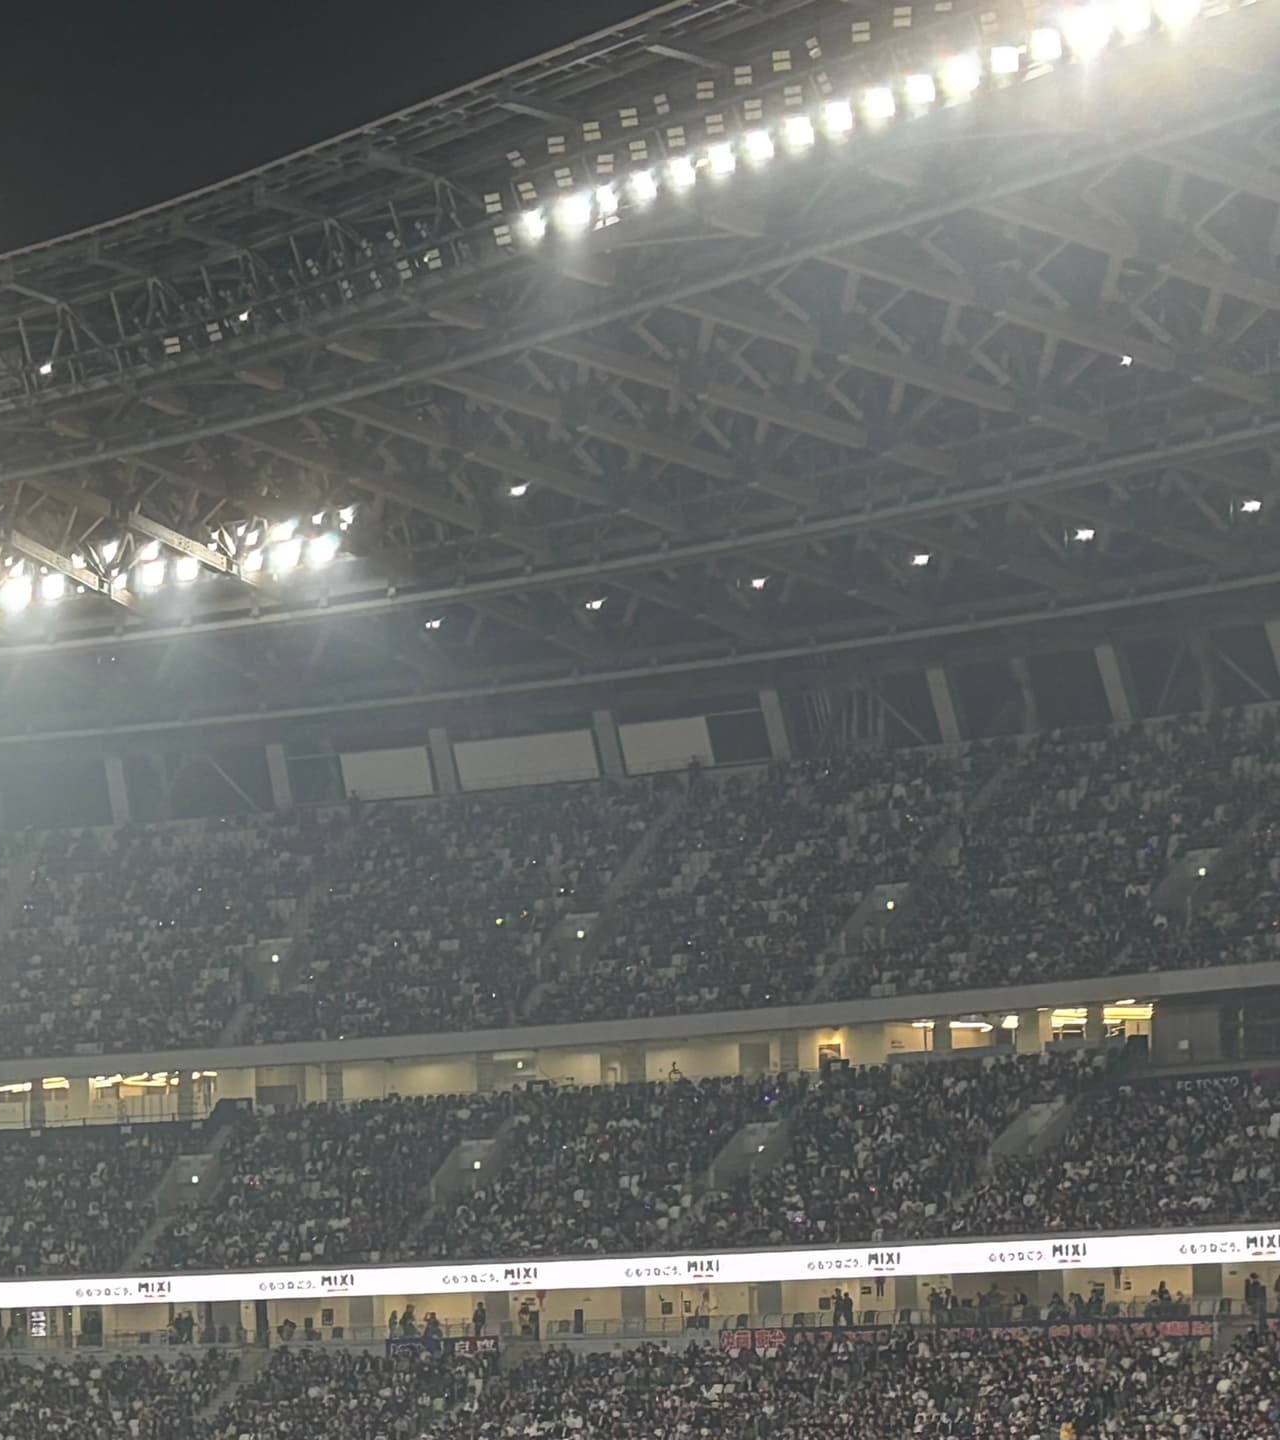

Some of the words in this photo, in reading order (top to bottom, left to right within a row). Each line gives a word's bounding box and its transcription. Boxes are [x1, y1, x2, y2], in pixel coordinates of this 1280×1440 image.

[1053, 1243, 1086, 1257] MIXI
[868, 1252, 900, 1265] MIXI
[688, 1259, 719, 1273] MIXI
[505, 1267, 537, 1279] MIXI
[322, 1274, 353, 1286] MIXI
[139, 1281, 170, 1293] MIXI
